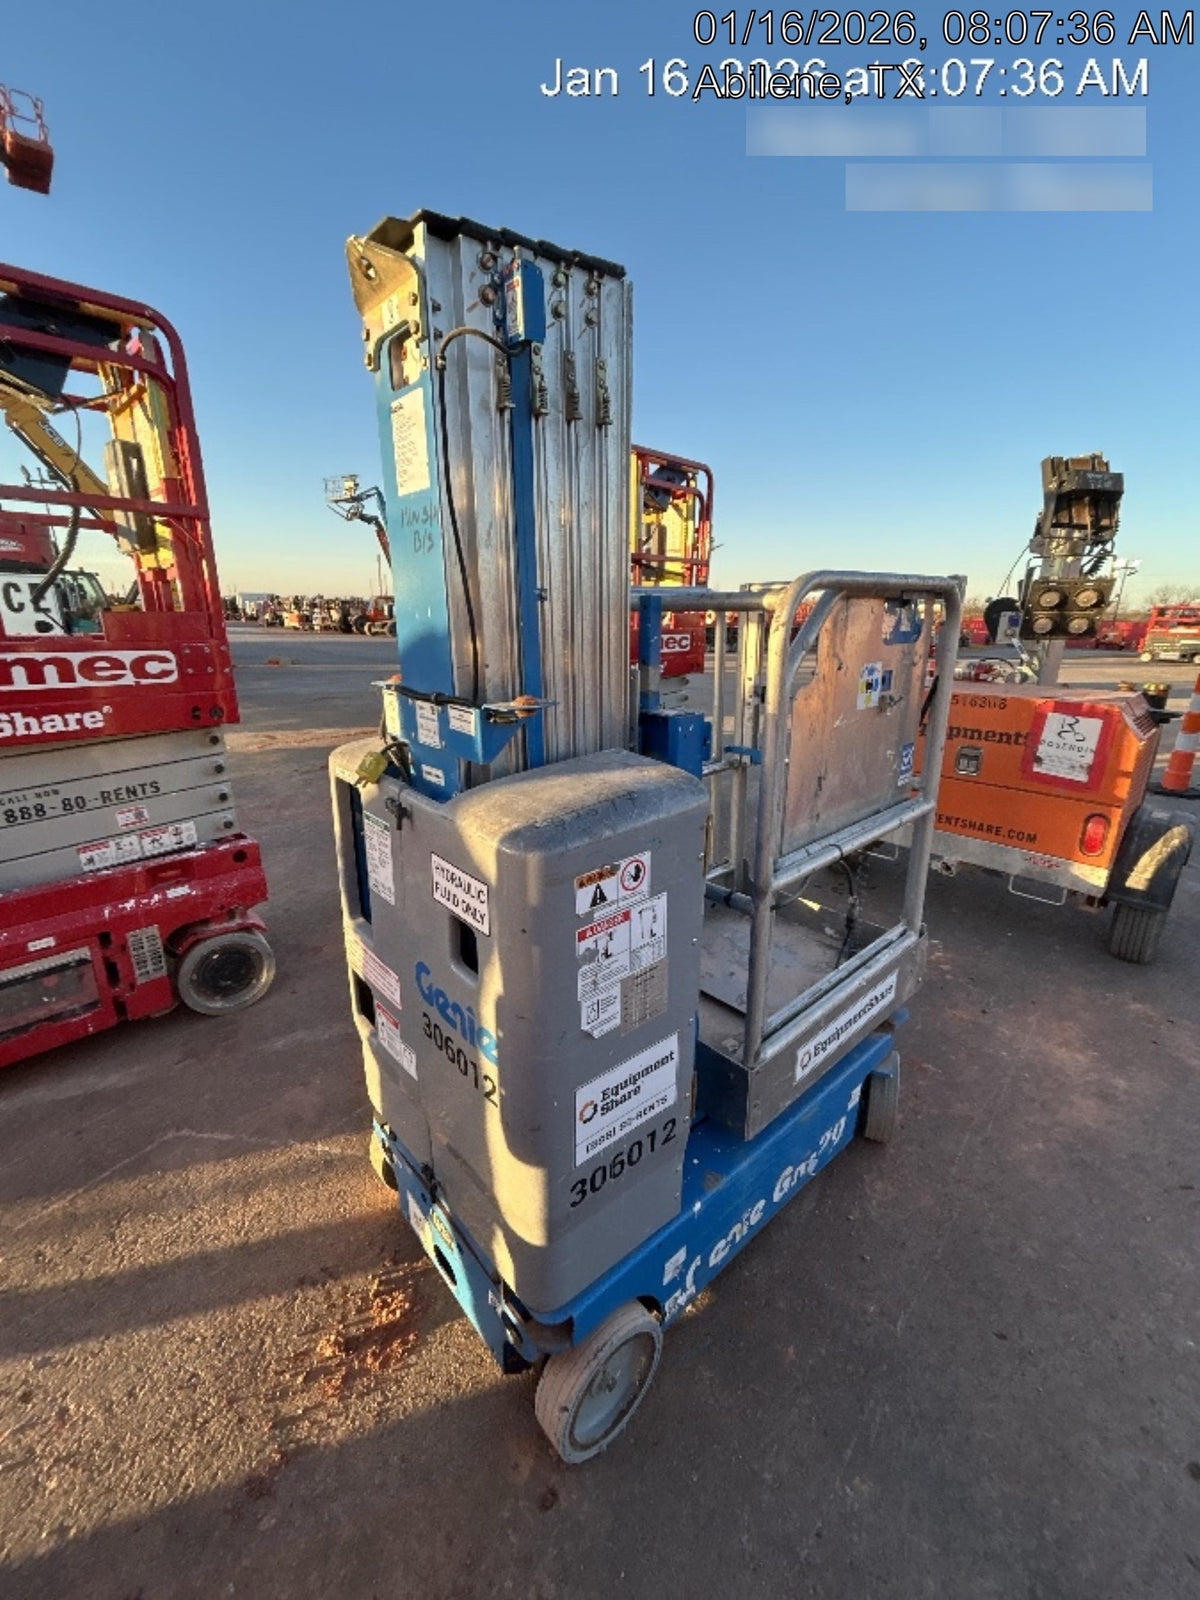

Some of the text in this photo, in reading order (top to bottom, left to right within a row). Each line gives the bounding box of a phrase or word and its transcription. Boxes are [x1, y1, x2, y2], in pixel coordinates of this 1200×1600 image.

[661, 636, 690, 651] ec
[936, 812, 1038, 844] ENTSHARE.COM
[415, 961, 499, 1067] Genie
[422, 1012, 498, 1108] 306012
[600, 1050, 675, 1103] Equipment
[600, 1085, 641, 1117] Share
[570, 1117, 677, 1208] 306012
